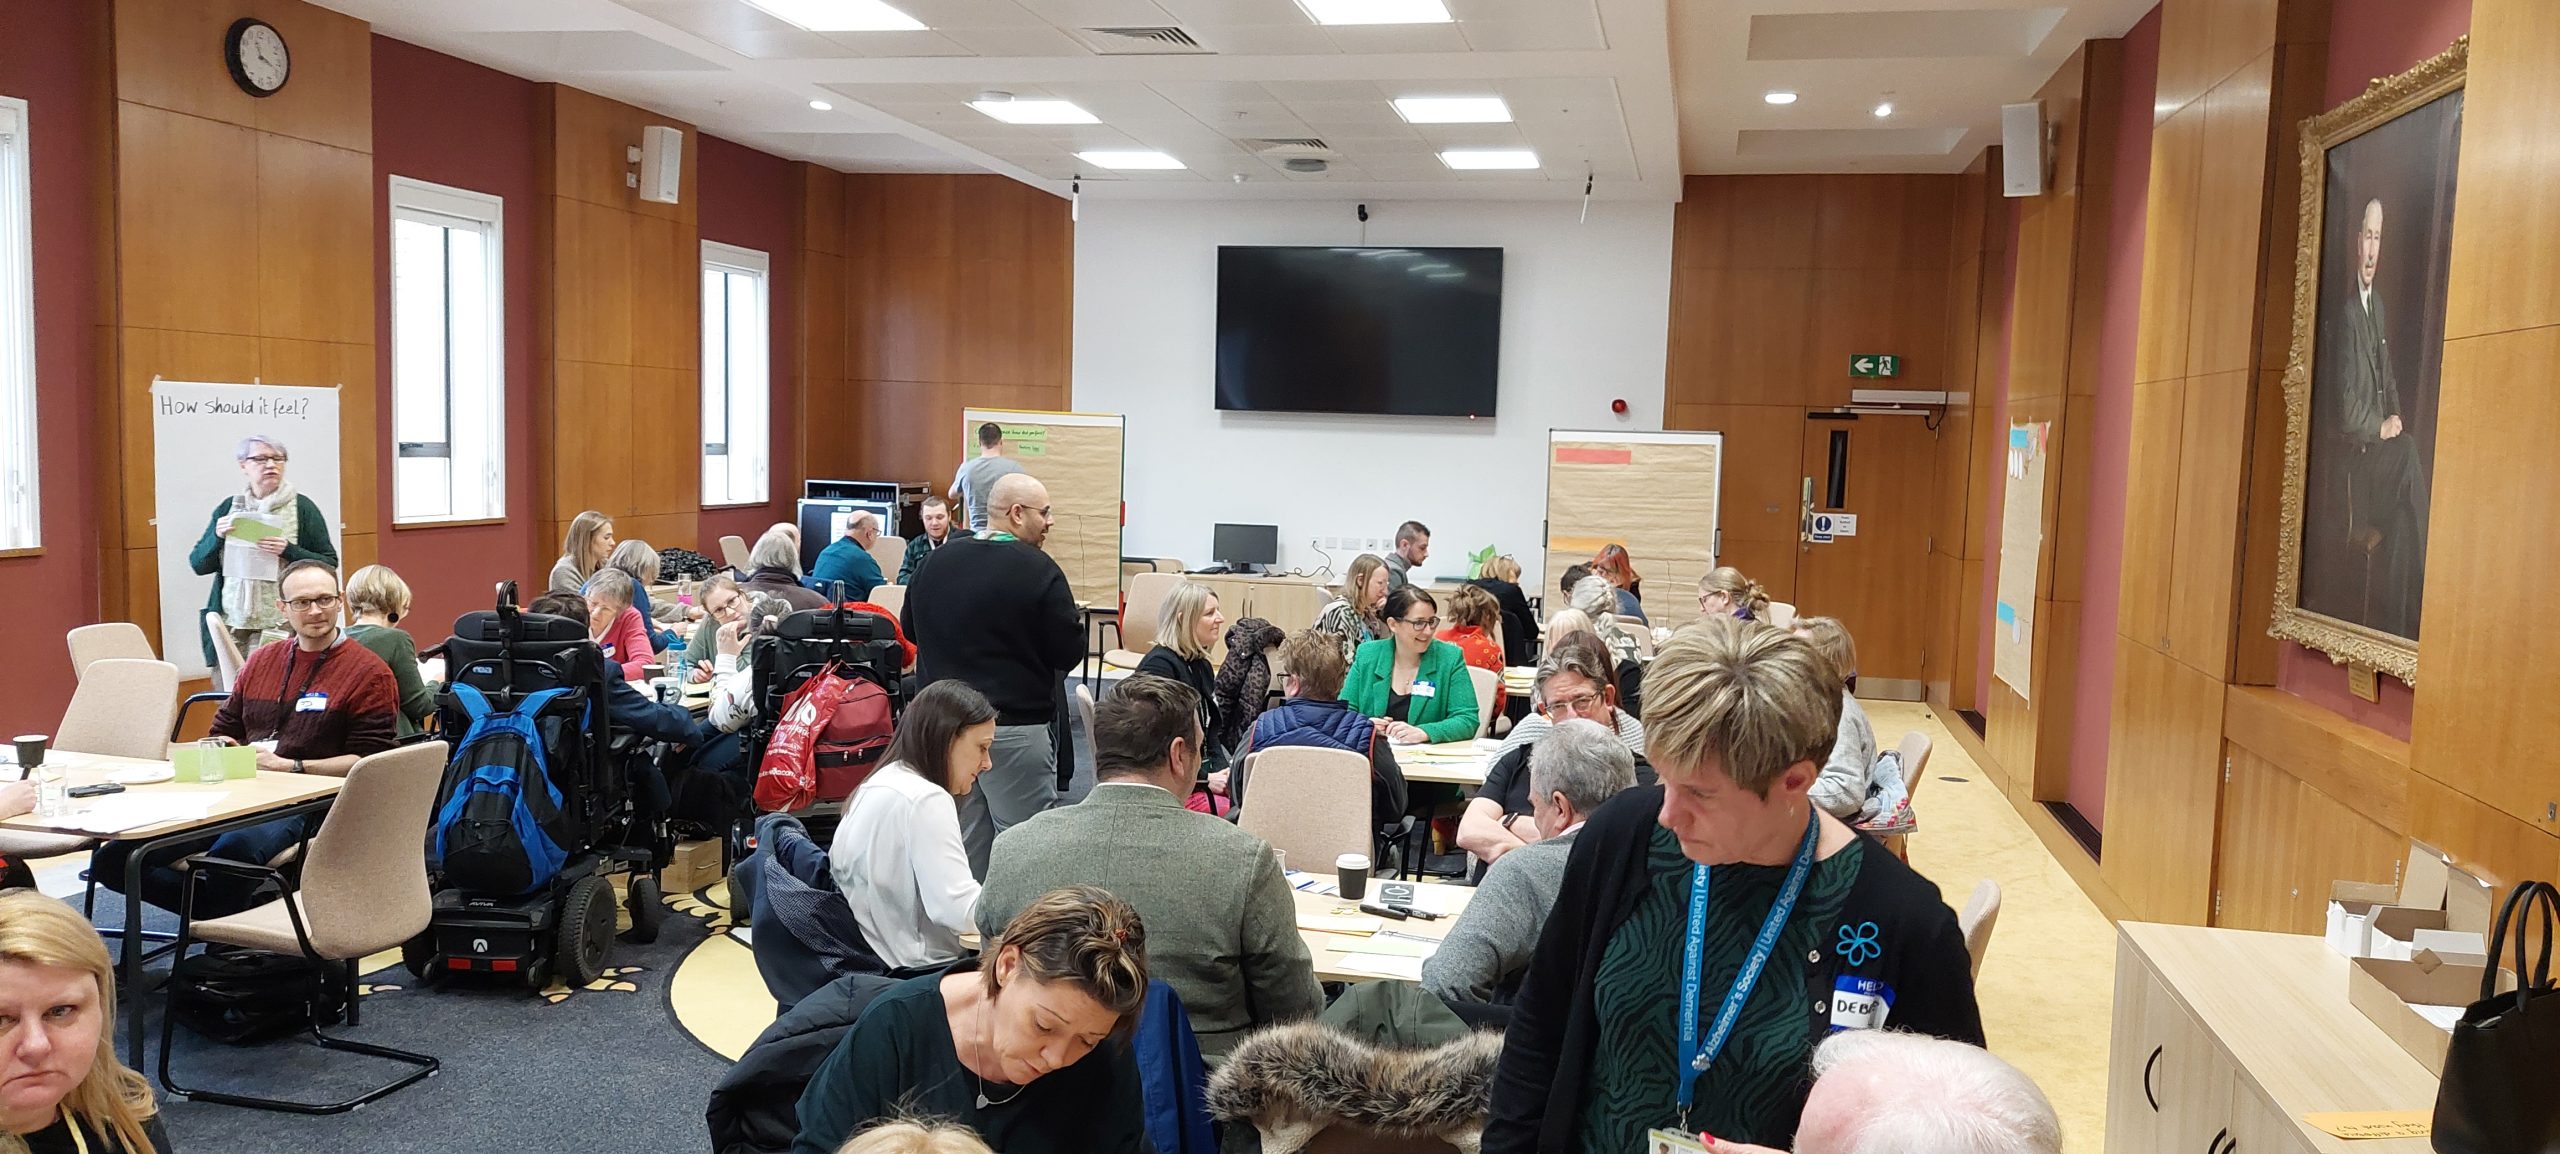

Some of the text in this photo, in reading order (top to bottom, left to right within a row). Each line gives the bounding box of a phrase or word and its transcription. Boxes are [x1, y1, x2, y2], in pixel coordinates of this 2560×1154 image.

[160, 395, 309, 420] How should it feel?
[1694, 864, 1709, 889] iety
[1692, 894, 1705, 935] United
[1687, 937, 1700, 981] Against
[1705, 995, 1744, 1056] Alzheimer's
[1737, 950, 1767, 992] Society
[1761, 906, 1786, 945] United
[1780, 866, 1807, 908] Against
[1683, 983, 1698, 1042] Dementia
